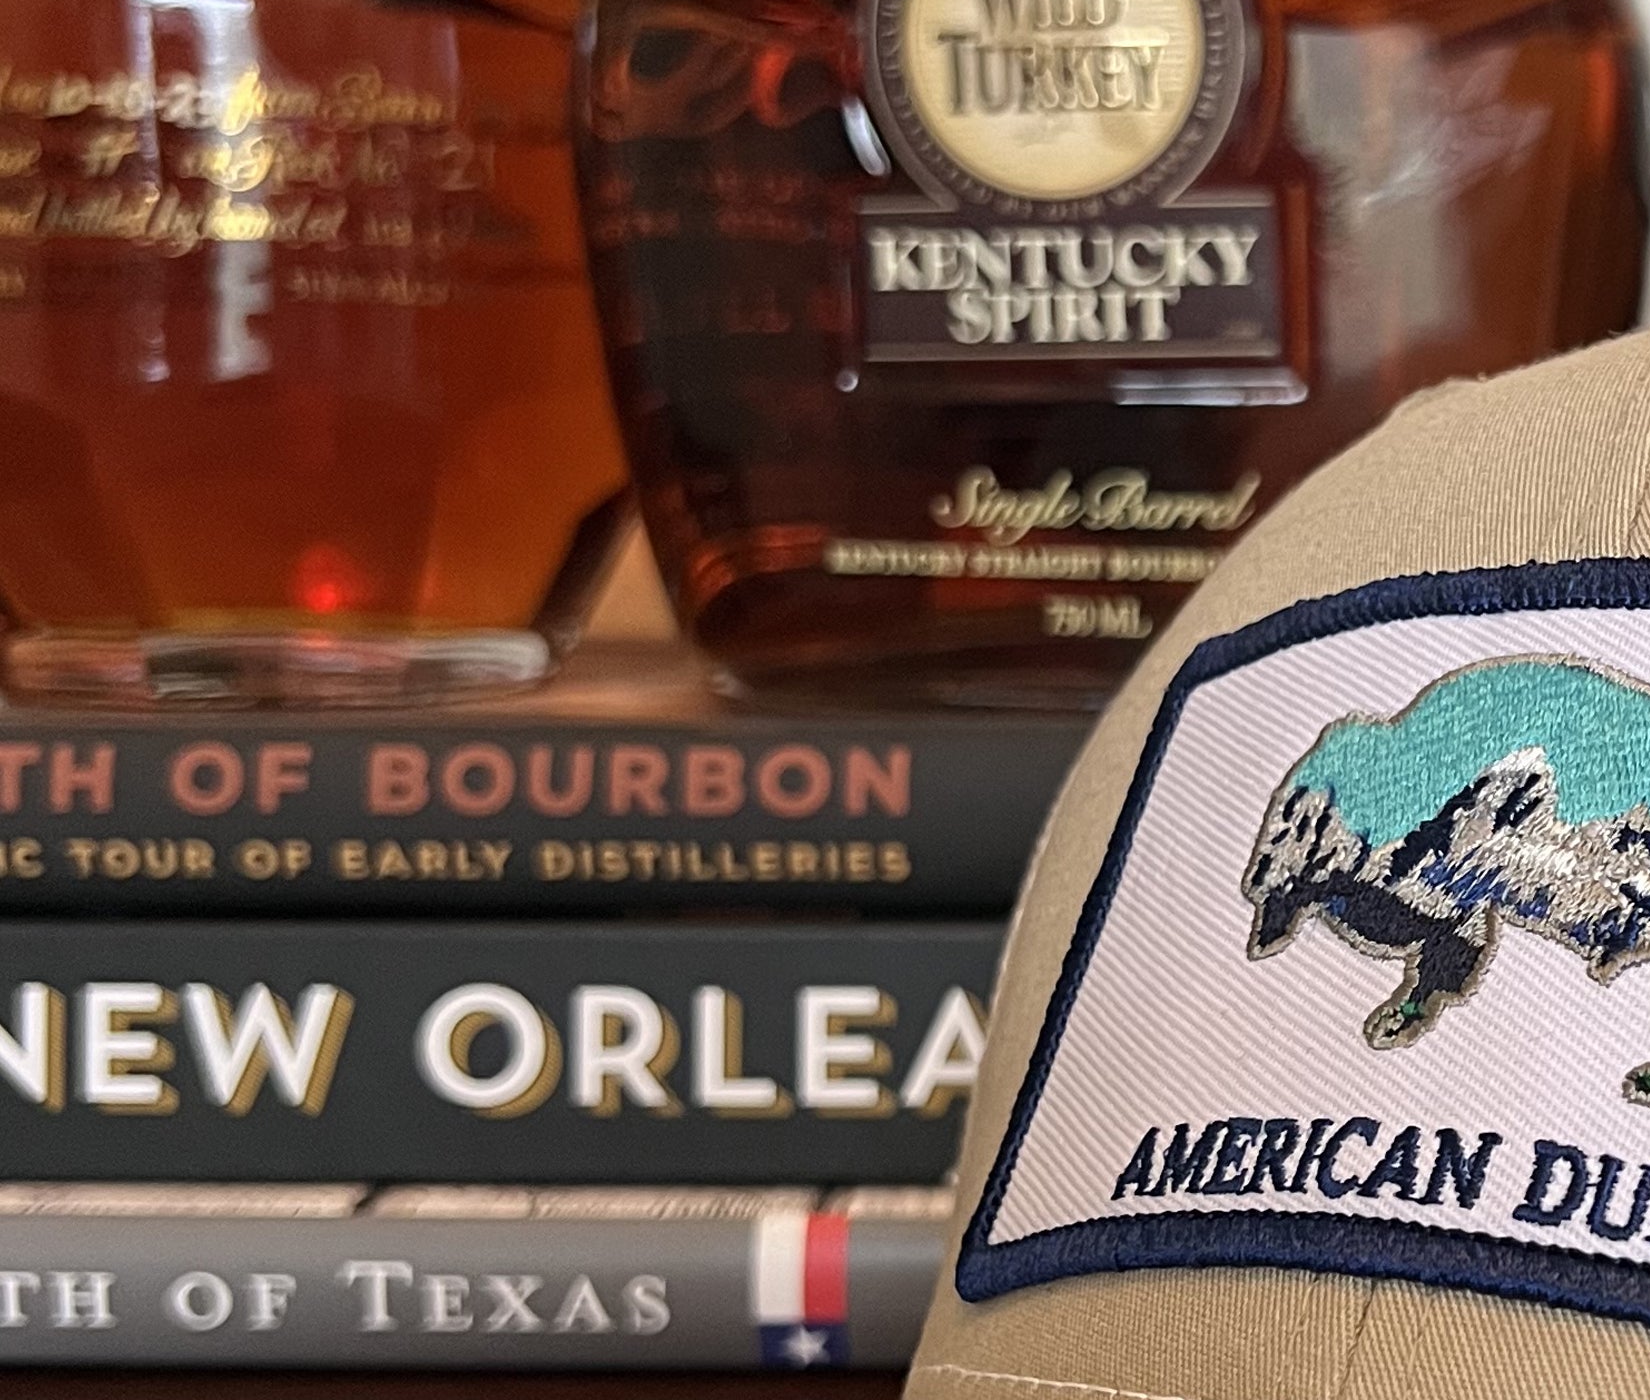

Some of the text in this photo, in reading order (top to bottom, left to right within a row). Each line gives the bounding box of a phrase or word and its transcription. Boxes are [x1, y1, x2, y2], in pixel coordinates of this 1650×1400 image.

[938, 30, 1171, 115] TURKEY
[865, 224, 1262, 292] KENTUCKY
[946, 285, 1182, 345] SPIRIT
[930, 464, 1263, 547] Single Barrel
[0, 741, 912, 818] TH OF BOURBON
[65, 837, 217, 881] TOUR
[234, 838, 312, 881] OF
[332, 838, 513, 881] EARLY
[537, 840, 912, 884] DISTILLERIES
[0, 981, 992, 1119] NEW ORLEA
[1110, 1117, 1504, 1210] AMERICAN
[0, 1259, 672, 1336] TH OF TEXAS
